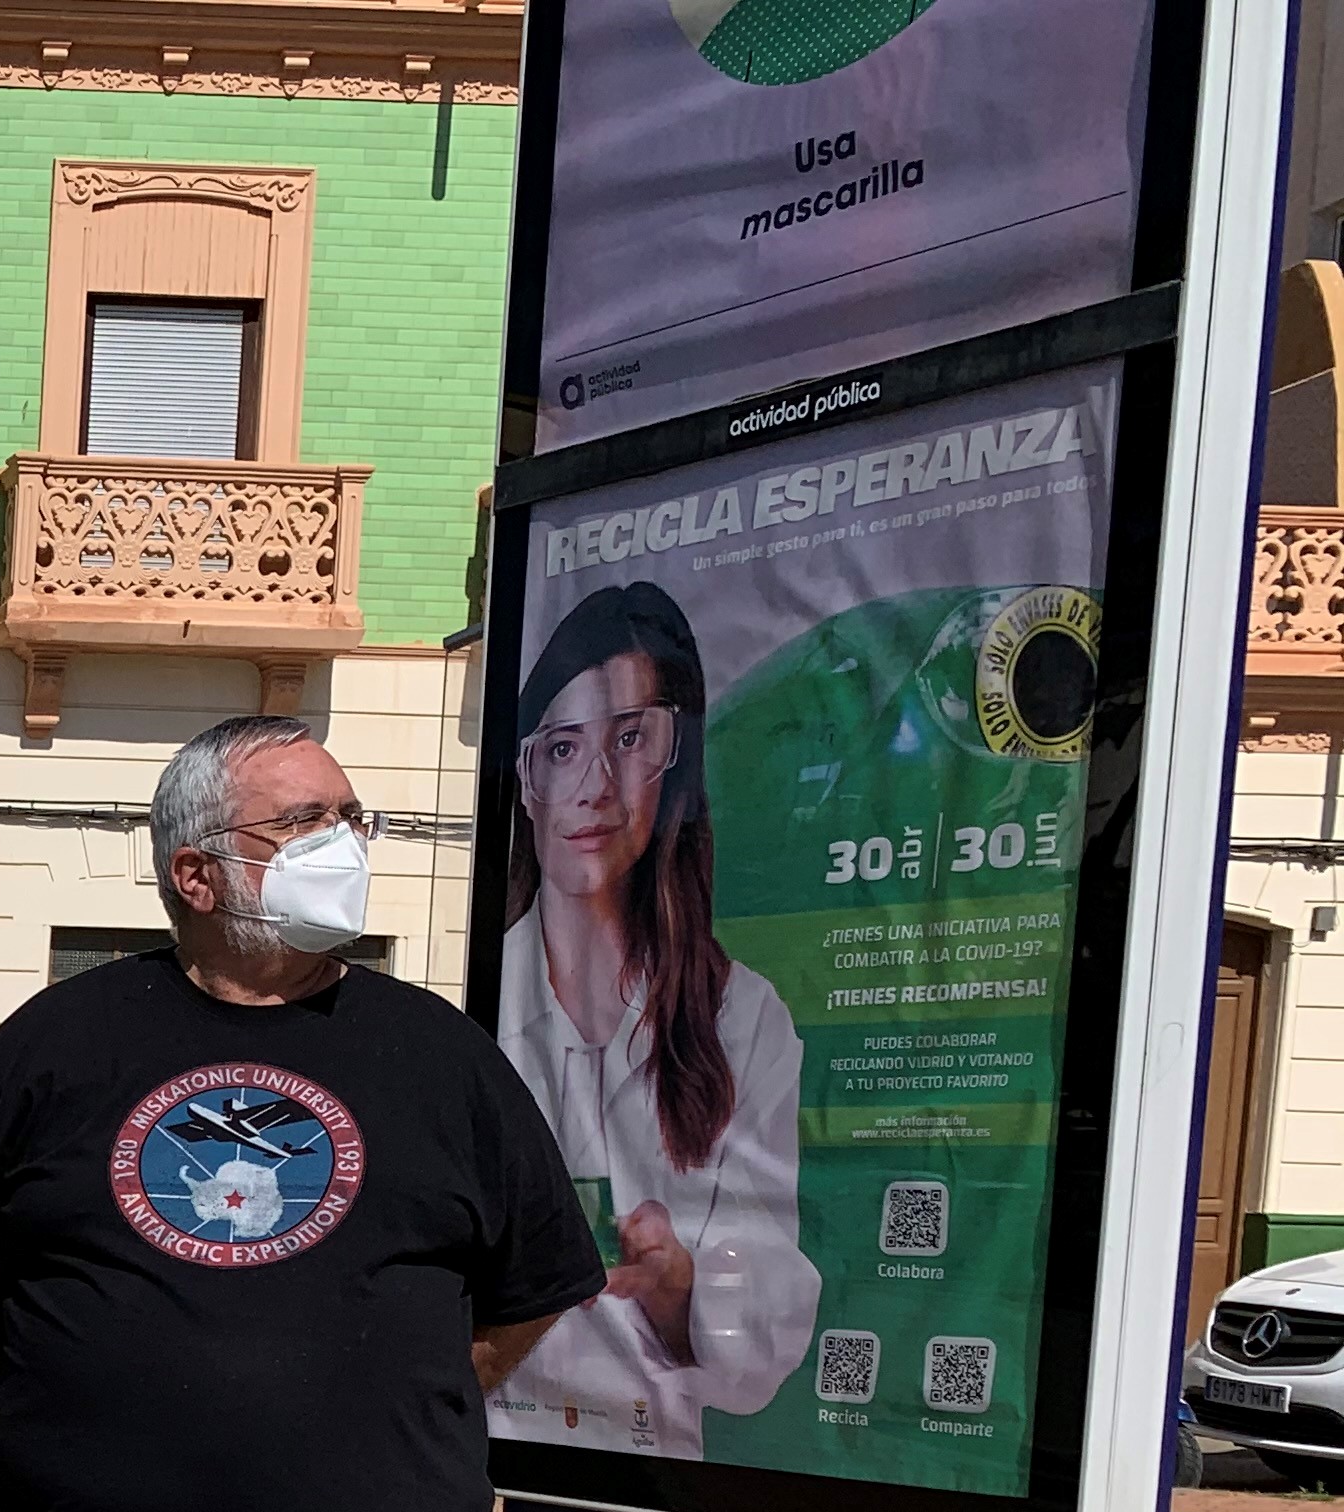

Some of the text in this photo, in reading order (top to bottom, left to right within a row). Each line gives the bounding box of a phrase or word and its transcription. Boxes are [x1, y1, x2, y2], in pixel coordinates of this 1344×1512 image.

[795, 130, 857, 174] Usa
[739, 157, 925, 241] mascarilla
[588, 360, 641, 386] actividad
[729, 379, 882, 438] actividad pública
[545, 408, 1099, 578] RECICLA ESPERANZA
[693, 554, 712, 572] Un
[713, 541, 764, 570] simple
[766, 531, 810, 560] gesto
[812, 525, 846, 549] para
[891, 512, 914, 531] un
[955, 493, 997, 520] paso
[1001, 484, 1042, 510] para
[825, 811, 1062, 885] 30 abr 30 jun
[823, 912, 1062, 949] ¿TIENES UNA INICIATIVA PARA
[834, 939, 1044, 970] COMBATIR A LA COVID-19?
[826, 977, 1048, 1011] ¡TIENES RECOMPENSA!
[863, 1032, 998, 1051] PUEDES COLABORAR
[830, 1051, 1034, 1072] RECICLANDO VIDRIO Y VOTANDO
[130, 1067, 351, 1132] MISKATONIC UNIVERSITY
[845, 1072, 1009, 1091] A TU PROYECTO FAVORITO
[114, 1139, 139, 1181] 1930
[336, 1139, 359, 1184] 1931
[120, 1192, 349, 1264] ANTARCTIC EXPEDITION
[876, 1261, 945, 1281] Colabora
[817, 1408, 870, 1429] Recicla
[919, 1417, 995, 1439] Comparte
